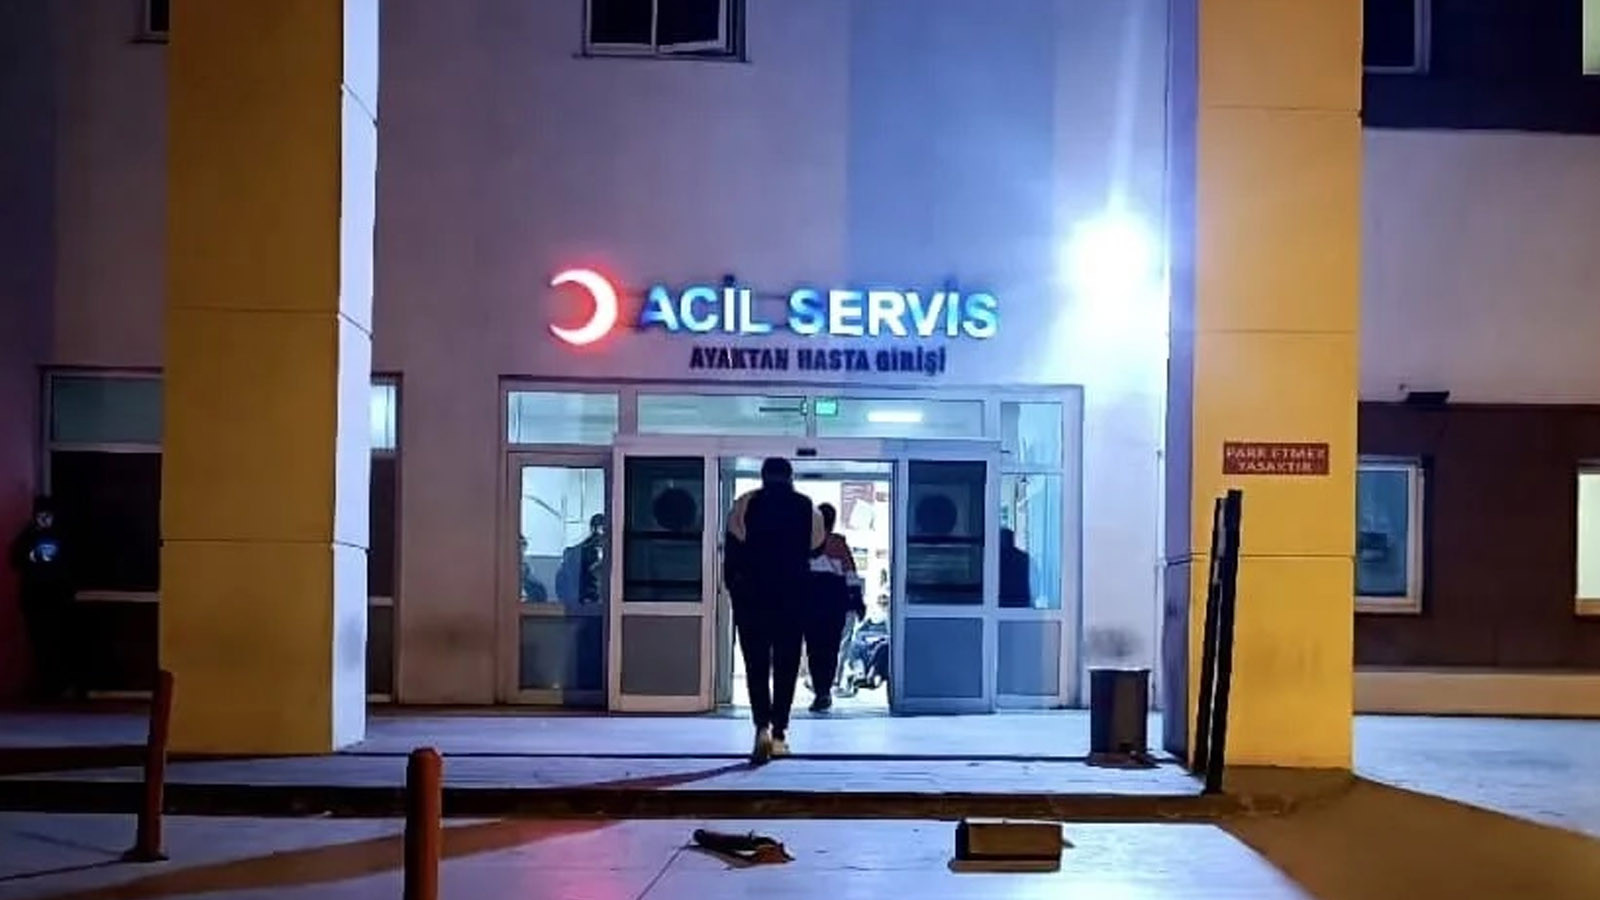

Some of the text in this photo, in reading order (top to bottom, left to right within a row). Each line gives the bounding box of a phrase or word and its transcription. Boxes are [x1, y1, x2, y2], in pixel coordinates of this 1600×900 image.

[642, 275, 770, 334] ACİL
[690, 346, 789, 371] AYAKTAN
[797, 350, 869, 372] HASTA
[1226, 446, 1267, 460] PARK
